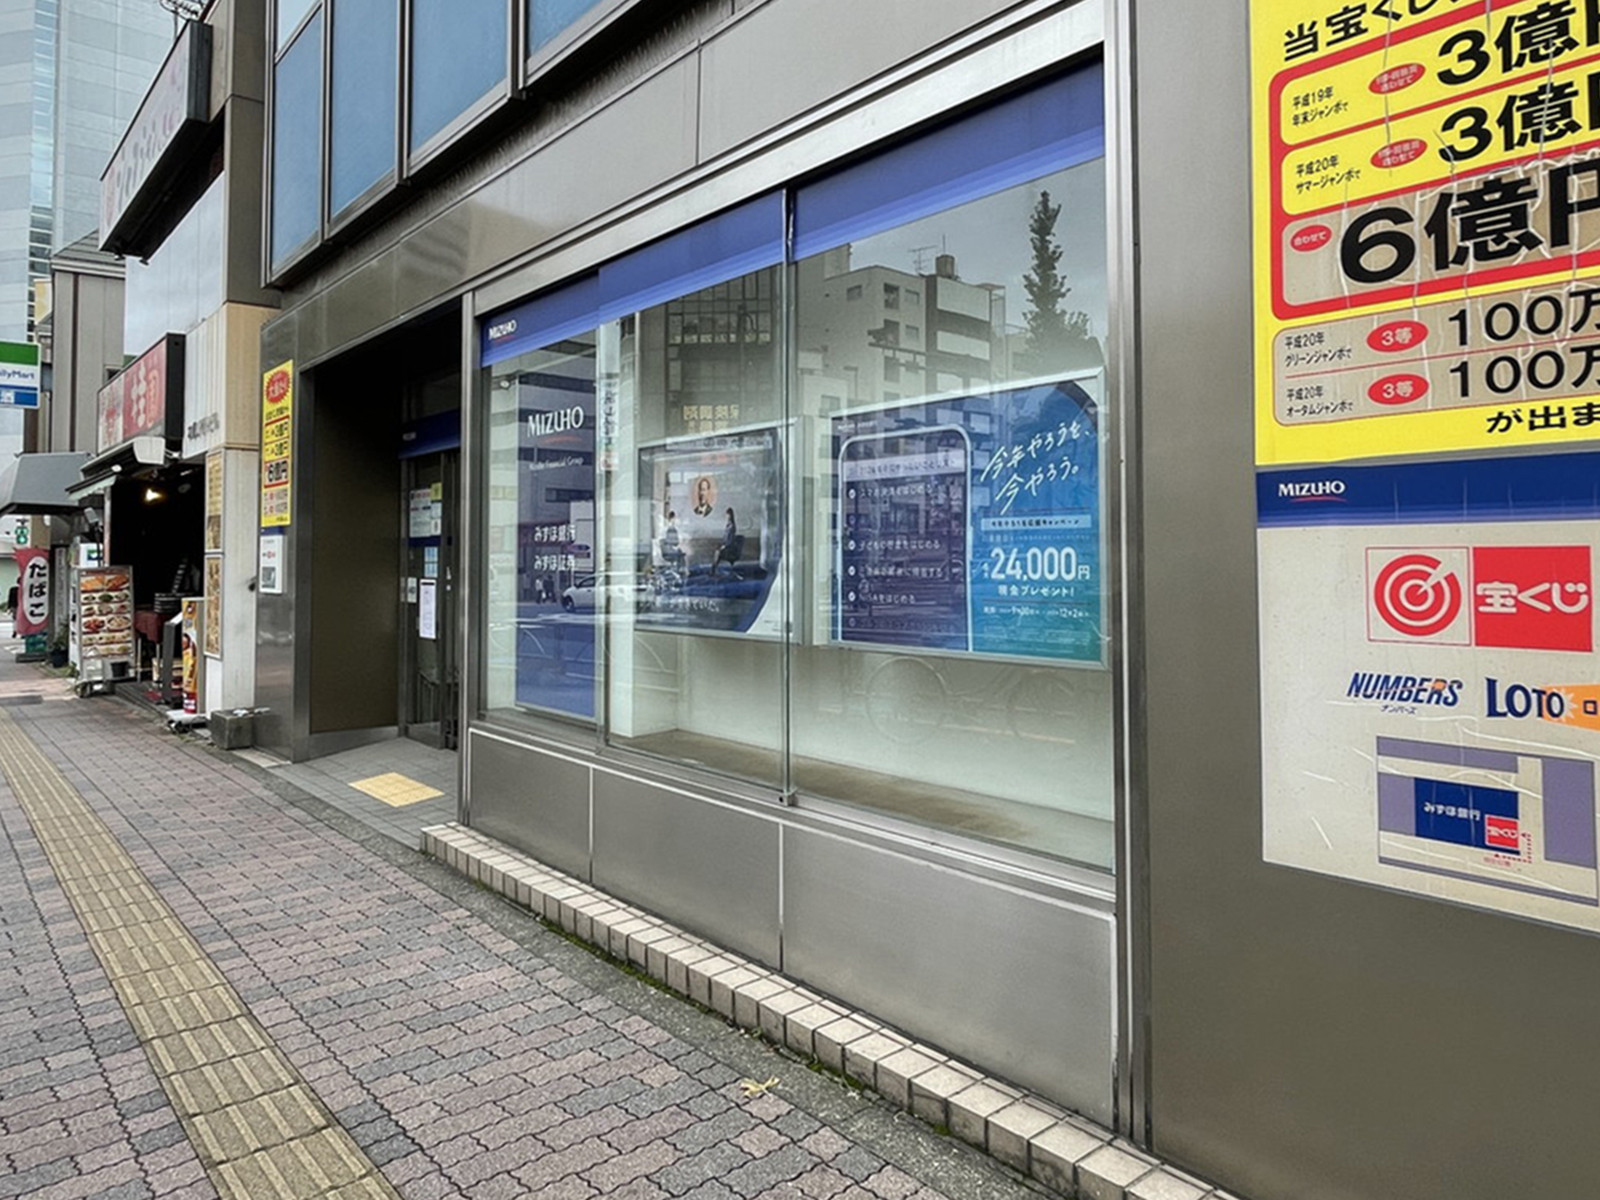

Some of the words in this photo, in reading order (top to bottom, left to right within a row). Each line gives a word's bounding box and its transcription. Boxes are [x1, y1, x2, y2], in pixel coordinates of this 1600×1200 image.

[1437, 0, 1600, 86] 3億
[1292, 86, 1334, 110] 平成19年
[1438, 71, 1600, 163] 3億
[1296, 154, 1339, 177] 平成20年
[488, 319, 518, 340] MIZUHO
[1284, 331, 1325, 350] 平成20年
[1381, 327, 1413, 346] 3等
[1286, 385, 1324, 402] 平成20年
[1382, 380, 1414, 399] 3等
[527, 405, 585, 438] MIZUHO
[995, 456, 1080, 516] 今やろう。
[1278, 480, 1346, 497] MIZUHO
[534, 524, 577, 543] みずほ銀行
[989, 546, 1091, 581] 24,000円
[28, 562, 47, 618] たばこ
[1476, 580, 1589, 613] 宝くじ
[1346, 672, 1464, 707] NUMBERS
[1485, 677, 1566, 719] LOTO
[1423, 801, 1481, 821] みずほ銀行
